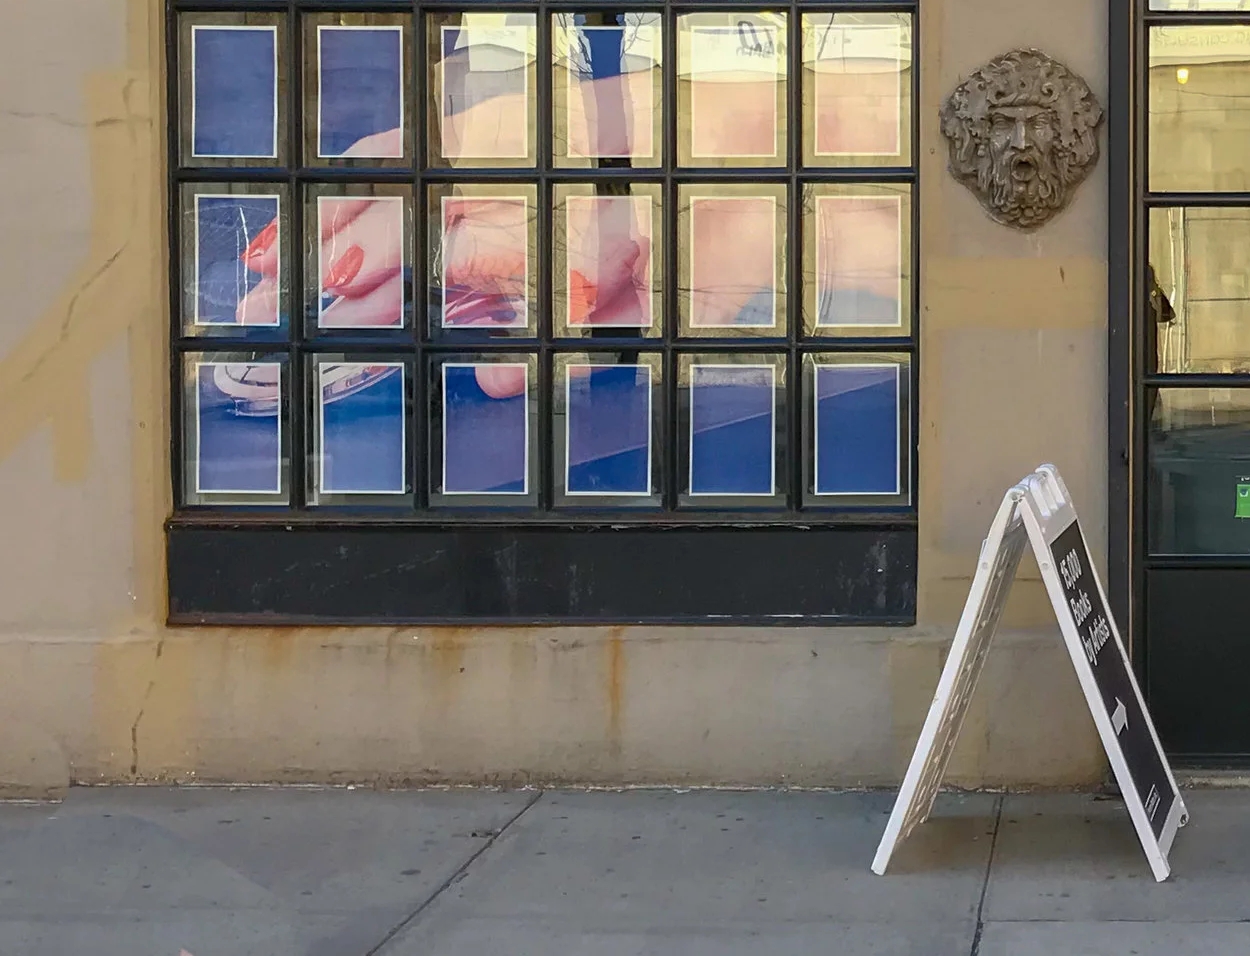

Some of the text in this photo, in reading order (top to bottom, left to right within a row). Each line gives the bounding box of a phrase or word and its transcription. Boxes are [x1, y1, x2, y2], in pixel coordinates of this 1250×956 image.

[1070, 589, 1092, 626] Books
[1082, 614, 1110, 666] by Artists
